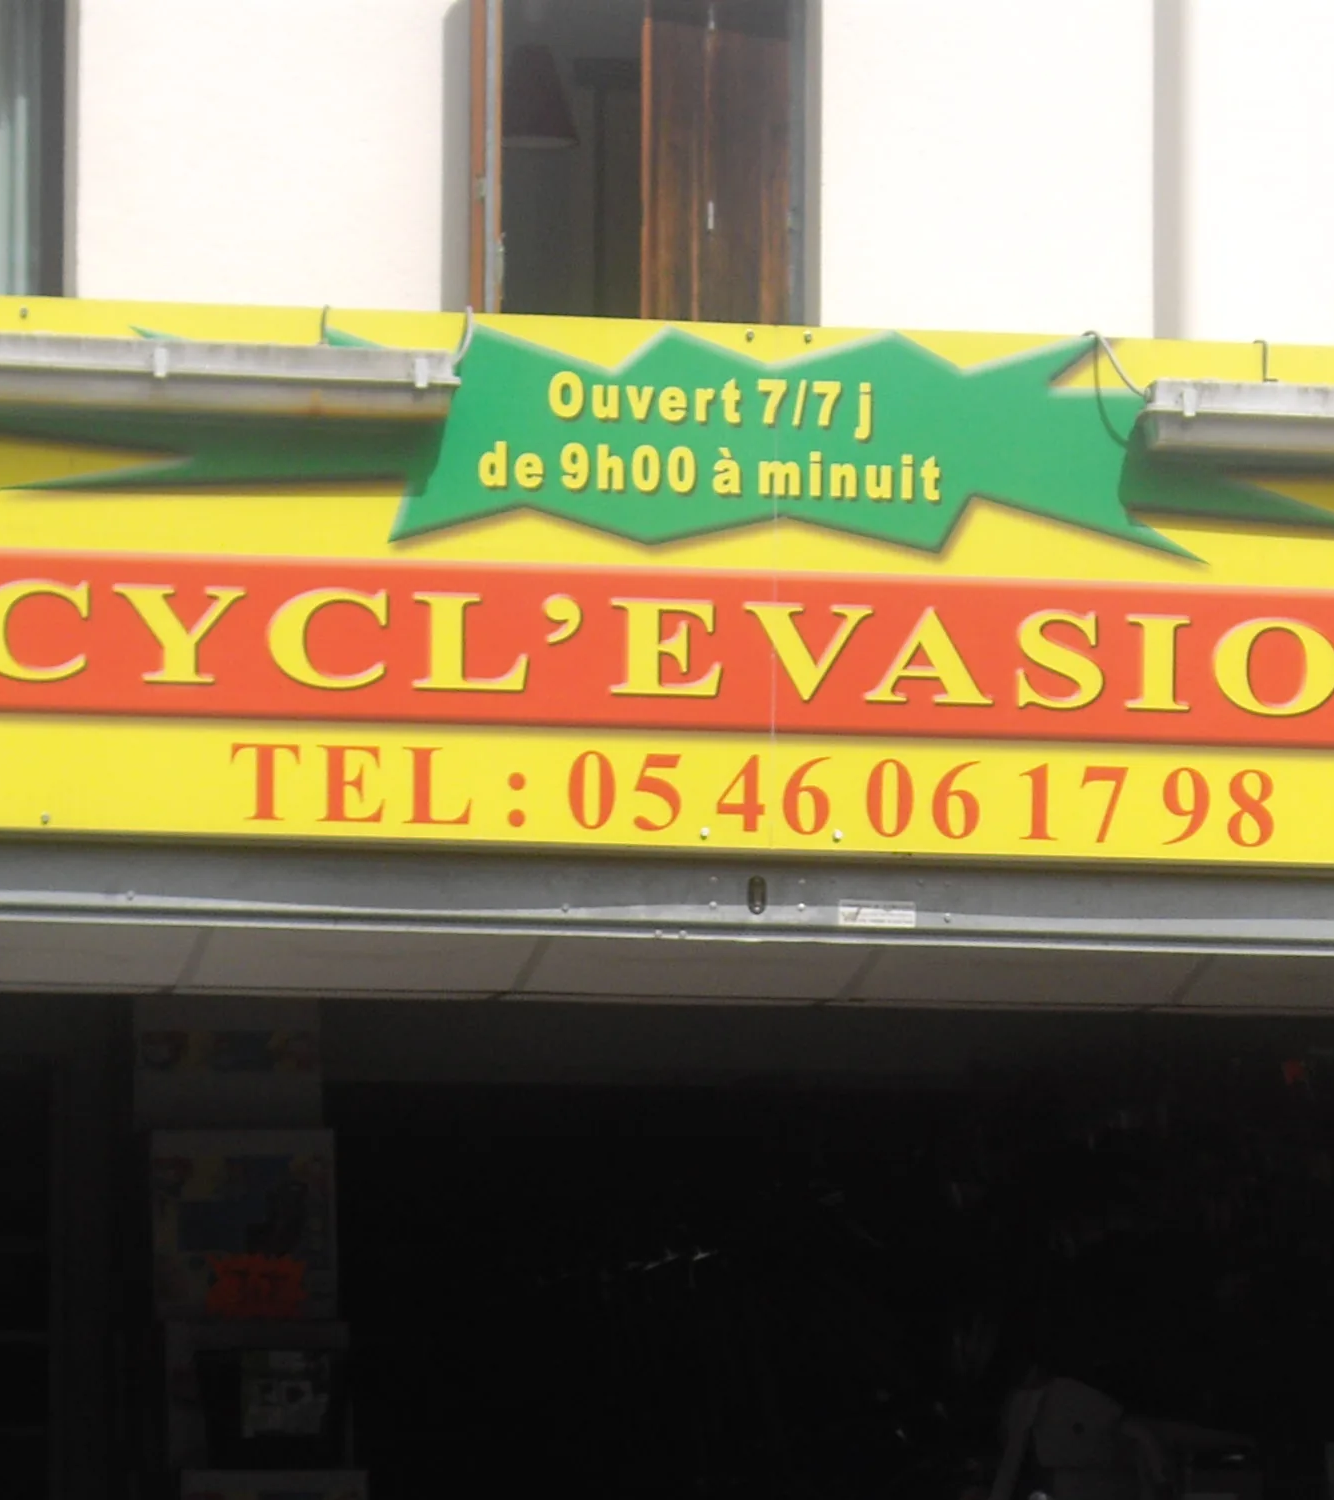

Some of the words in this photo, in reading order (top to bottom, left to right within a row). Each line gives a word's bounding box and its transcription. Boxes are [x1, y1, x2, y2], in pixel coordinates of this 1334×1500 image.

[548, 371, 742, 425] Ouvert
[756, 378, 844, 430] 7/7
[855, 382, 873, 440] j
[478, 441, 544, 488] de
[561, 442, 696, 494] 9h00
[712, 446, 742, 496] à
[758, 451, 941, 502] minuit
